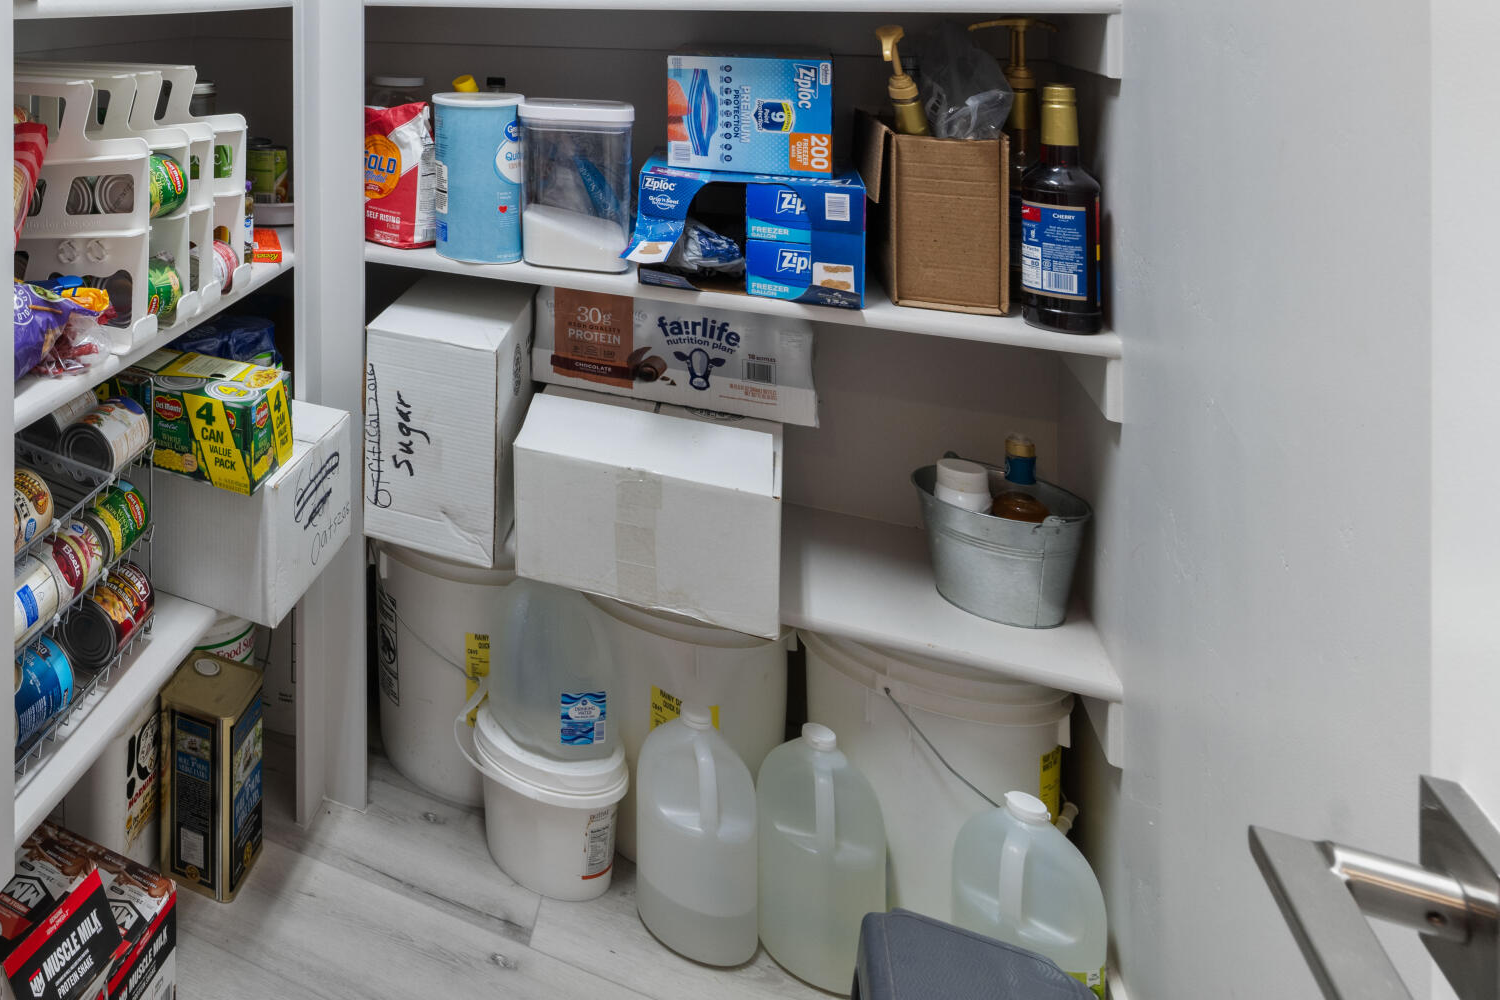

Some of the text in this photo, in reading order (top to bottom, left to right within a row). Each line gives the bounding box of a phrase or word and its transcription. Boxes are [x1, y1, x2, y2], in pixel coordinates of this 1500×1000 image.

[794, 66, 816, 110] Ziploc
[740, 85, 751, 144] PREMIUM
[810, 135, 829, 170] 200
[644, 176, 677, 192] Ziploc
[751, 226, 789, 236] FREEZER
[576, 306, 613, 326] 30g
[568, 327, 621, 346] PROTEIN
[666, 335, 735, 355] nutrition plan
[195, 402, 216, 426] 4
[201, 427, 224, 444] CAN
[393, 389, 431, 477] Sugar
[209, 444, 232, 458] VALUE
[214, 457, 237, 471] PACK
[62, 543, 80, 578] Beets
[42, 908, 103, 977] MUSCLE MILK
[57, 955, 95, 1000] PROTEIN SHAKE
